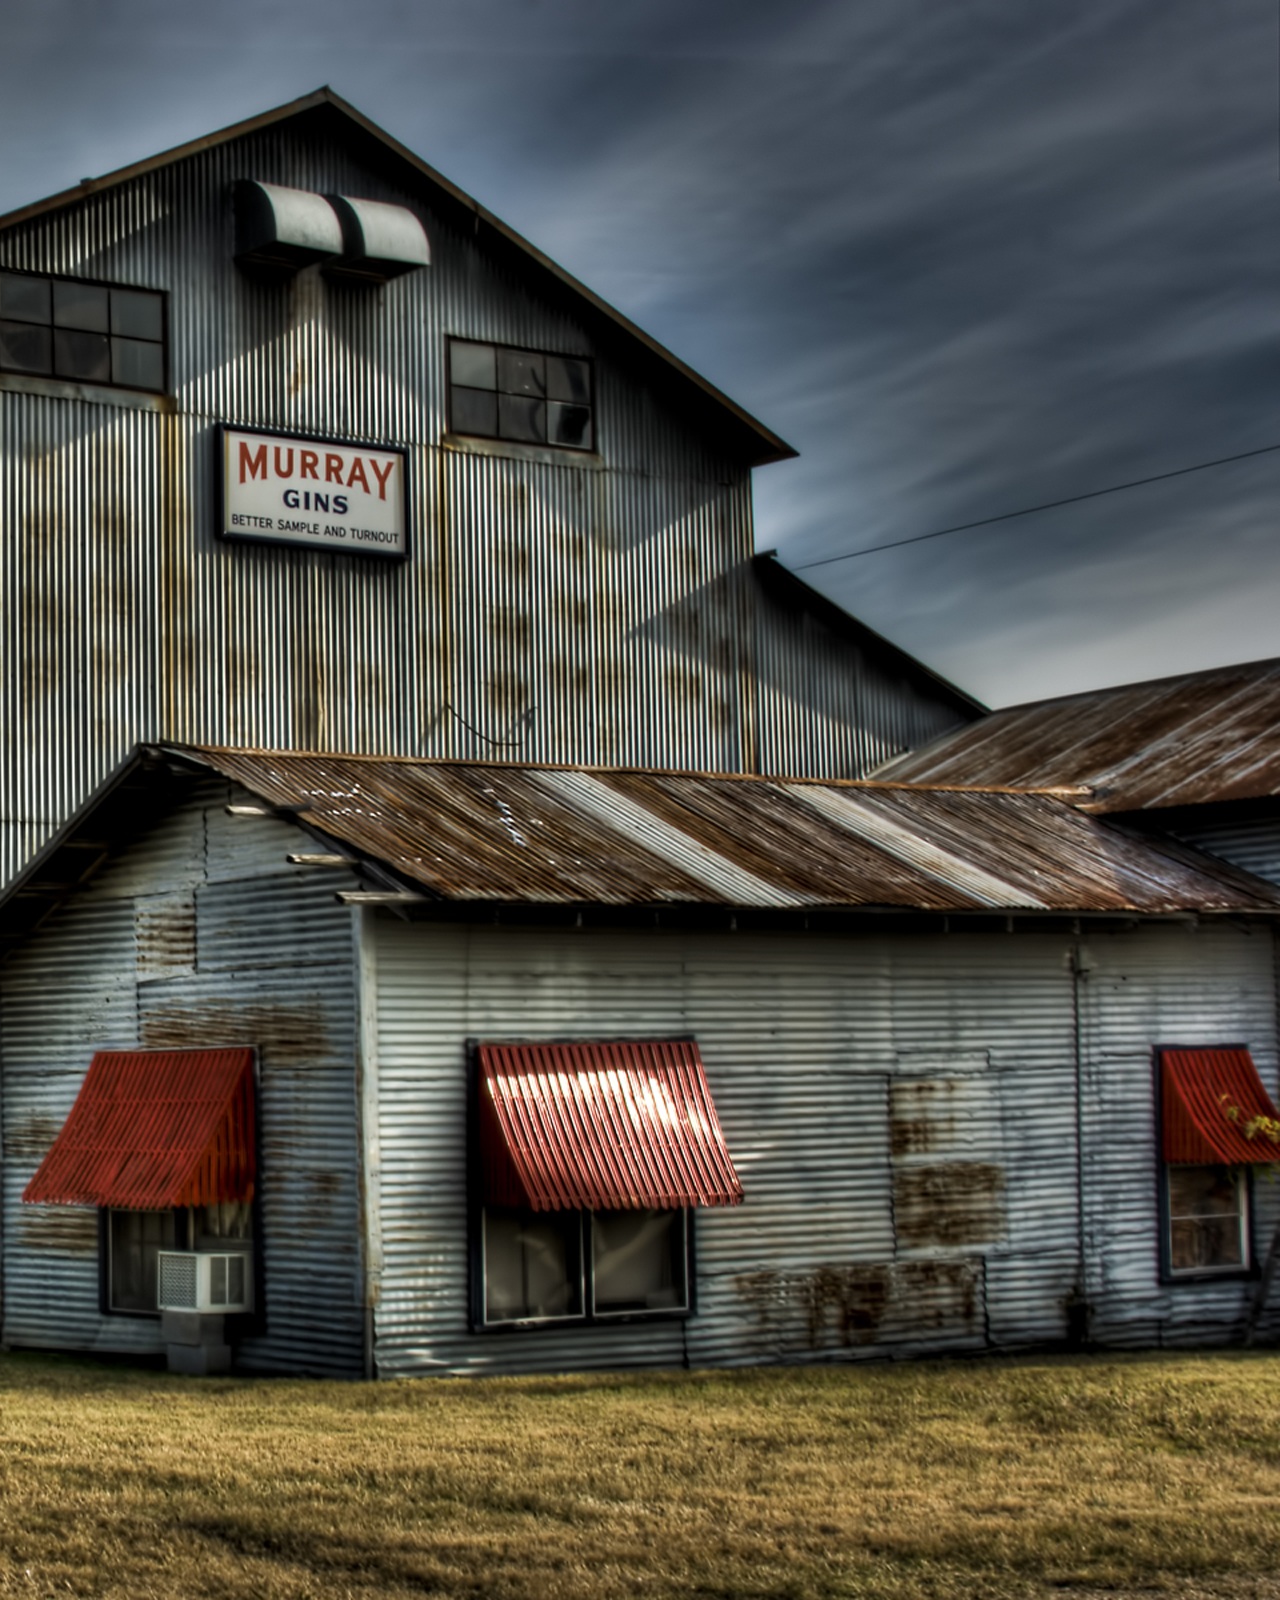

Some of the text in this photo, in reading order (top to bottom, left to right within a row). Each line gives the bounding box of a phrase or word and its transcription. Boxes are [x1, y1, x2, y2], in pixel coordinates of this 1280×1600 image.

[239, 441, 395, 501] MURRAY
[283, 489, 349, 514] GINS
[231, 513, 399, 544] BETTER SAMPLE AND TURNOUT
